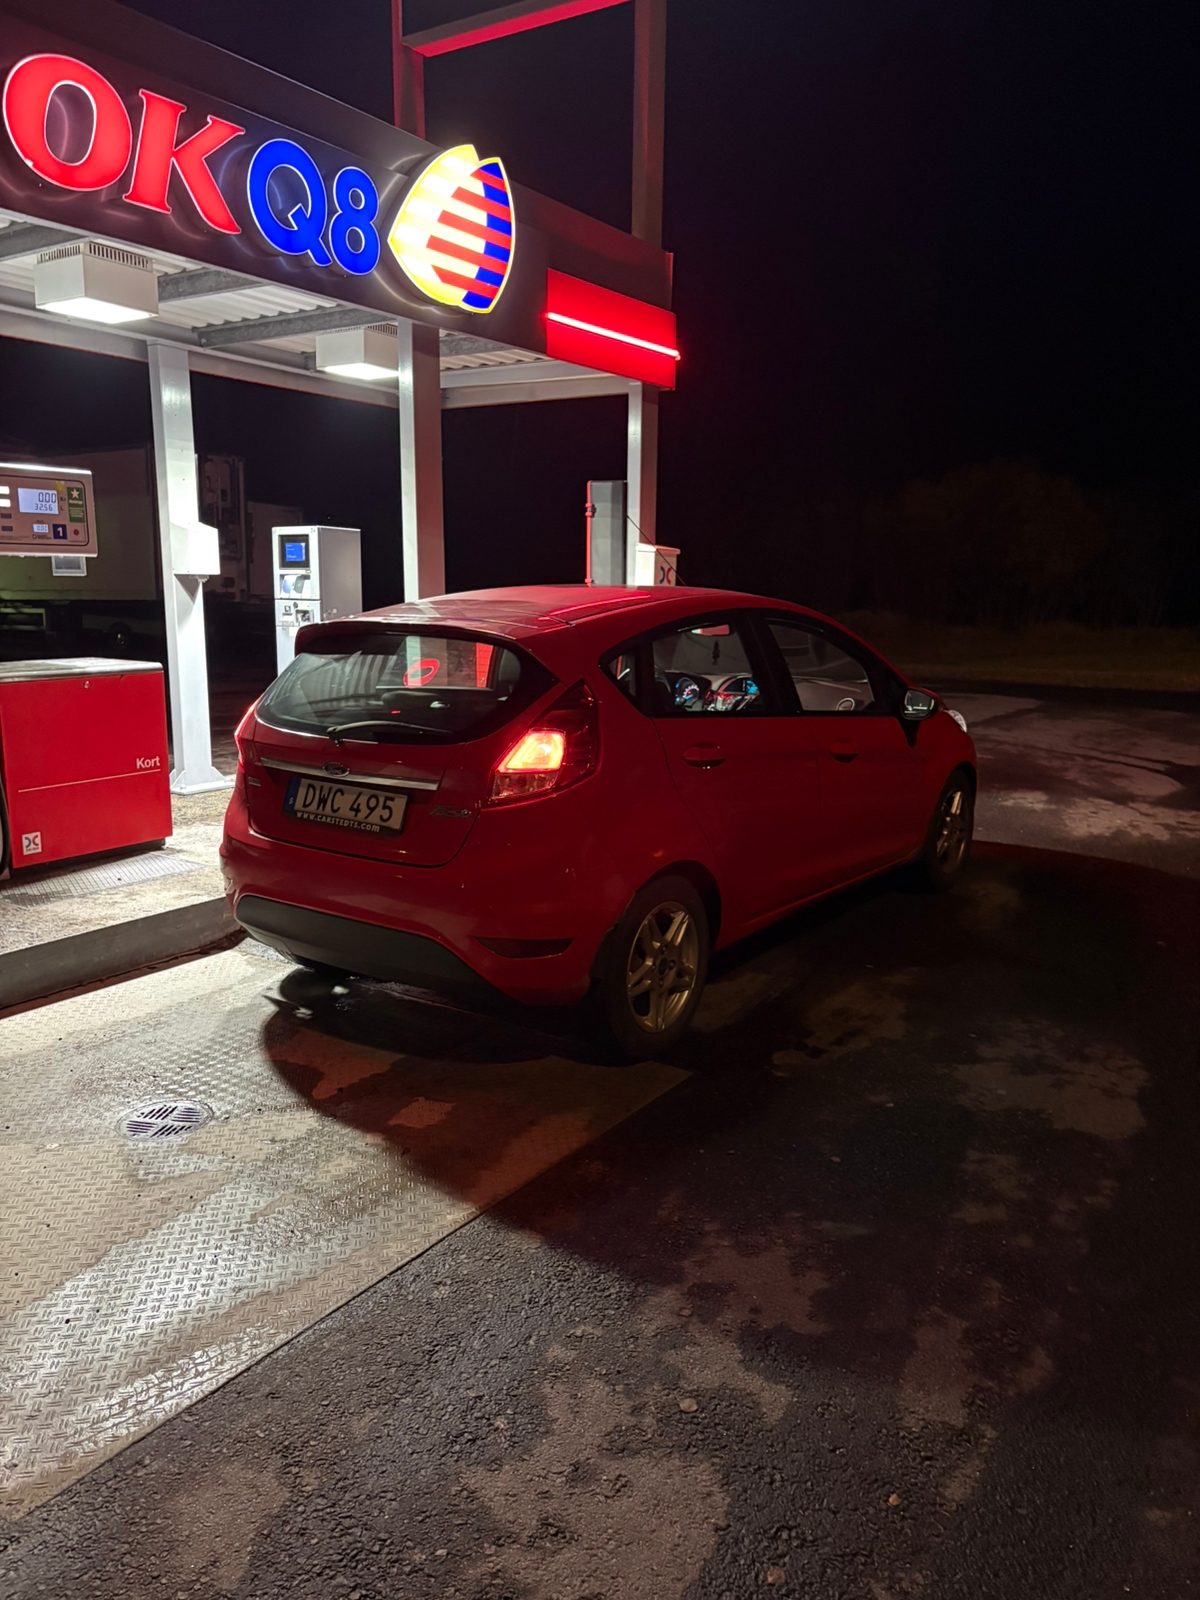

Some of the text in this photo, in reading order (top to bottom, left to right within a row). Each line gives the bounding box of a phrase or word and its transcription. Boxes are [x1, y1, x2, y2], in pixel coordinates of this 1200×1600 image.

[136, 756, 161, 769] Kort
[302, 783, 345, 814] DWC
[349, 791, 396, 823] 495
